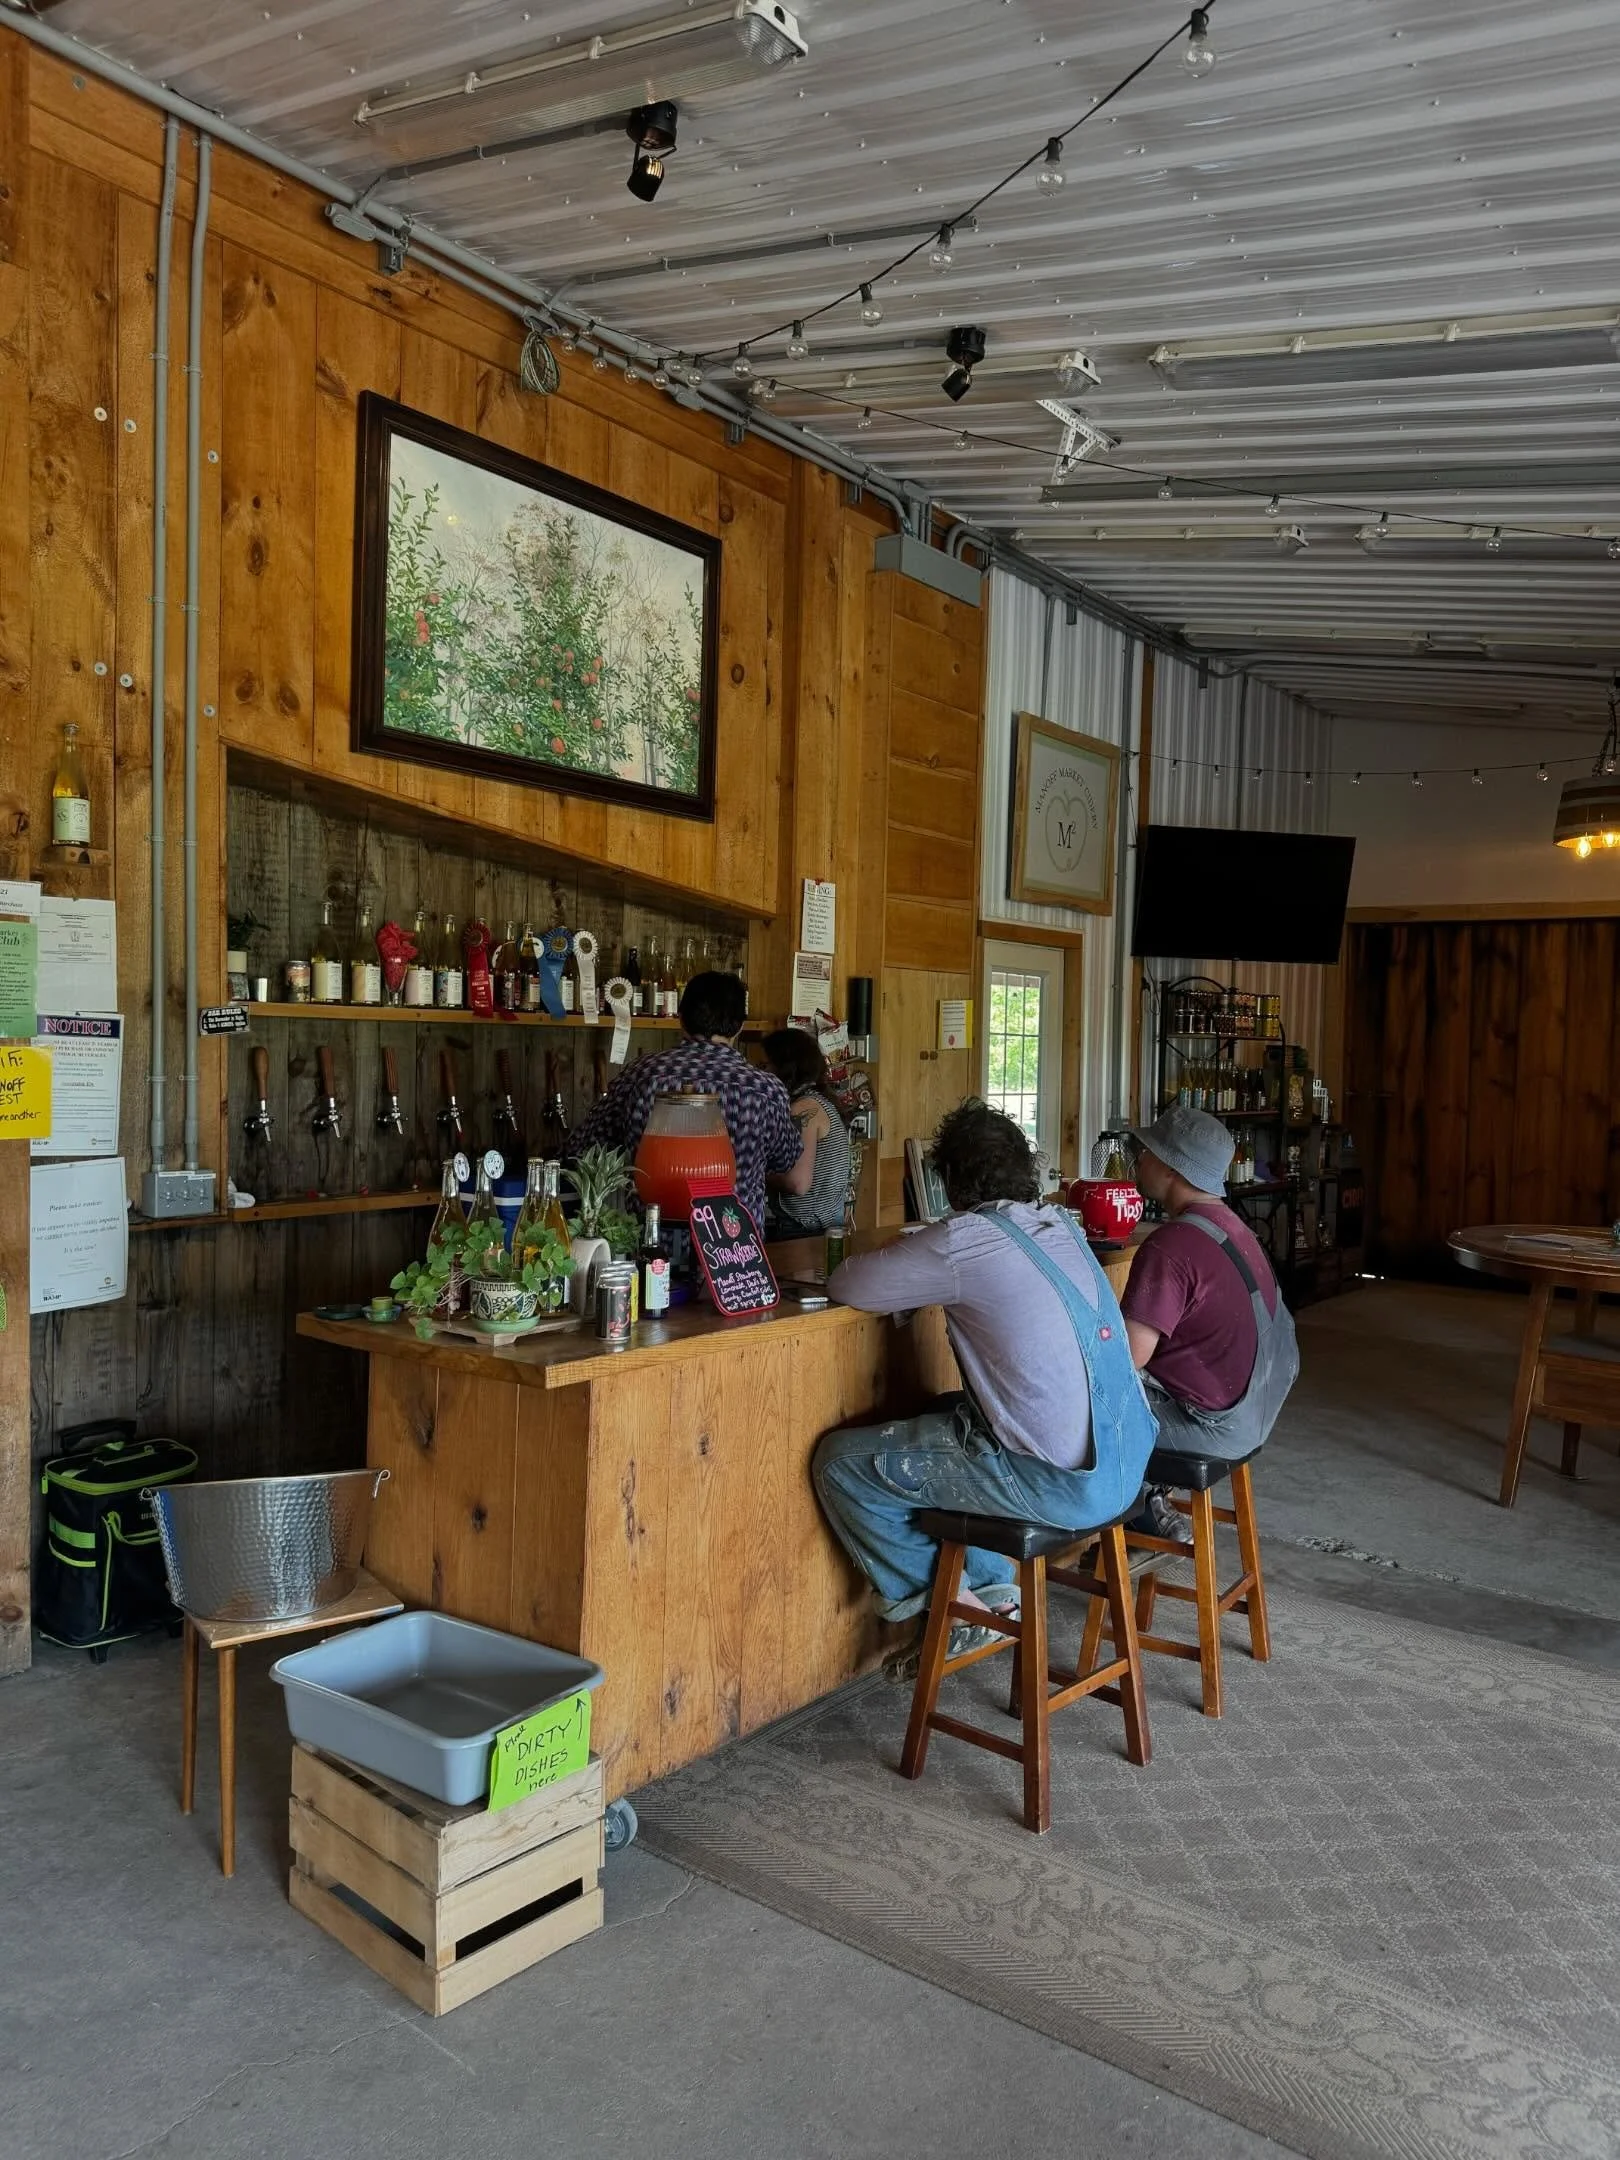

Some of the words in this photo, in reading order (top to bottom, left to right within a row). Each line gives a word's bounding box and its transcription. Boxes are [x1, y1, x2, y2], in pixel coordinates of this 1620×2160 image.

[44, 1018, 112, 1035] NOTICE
[517, 1717, 572, 1761] DIRTY
[514, 1747, 568, 1786] DISHES
